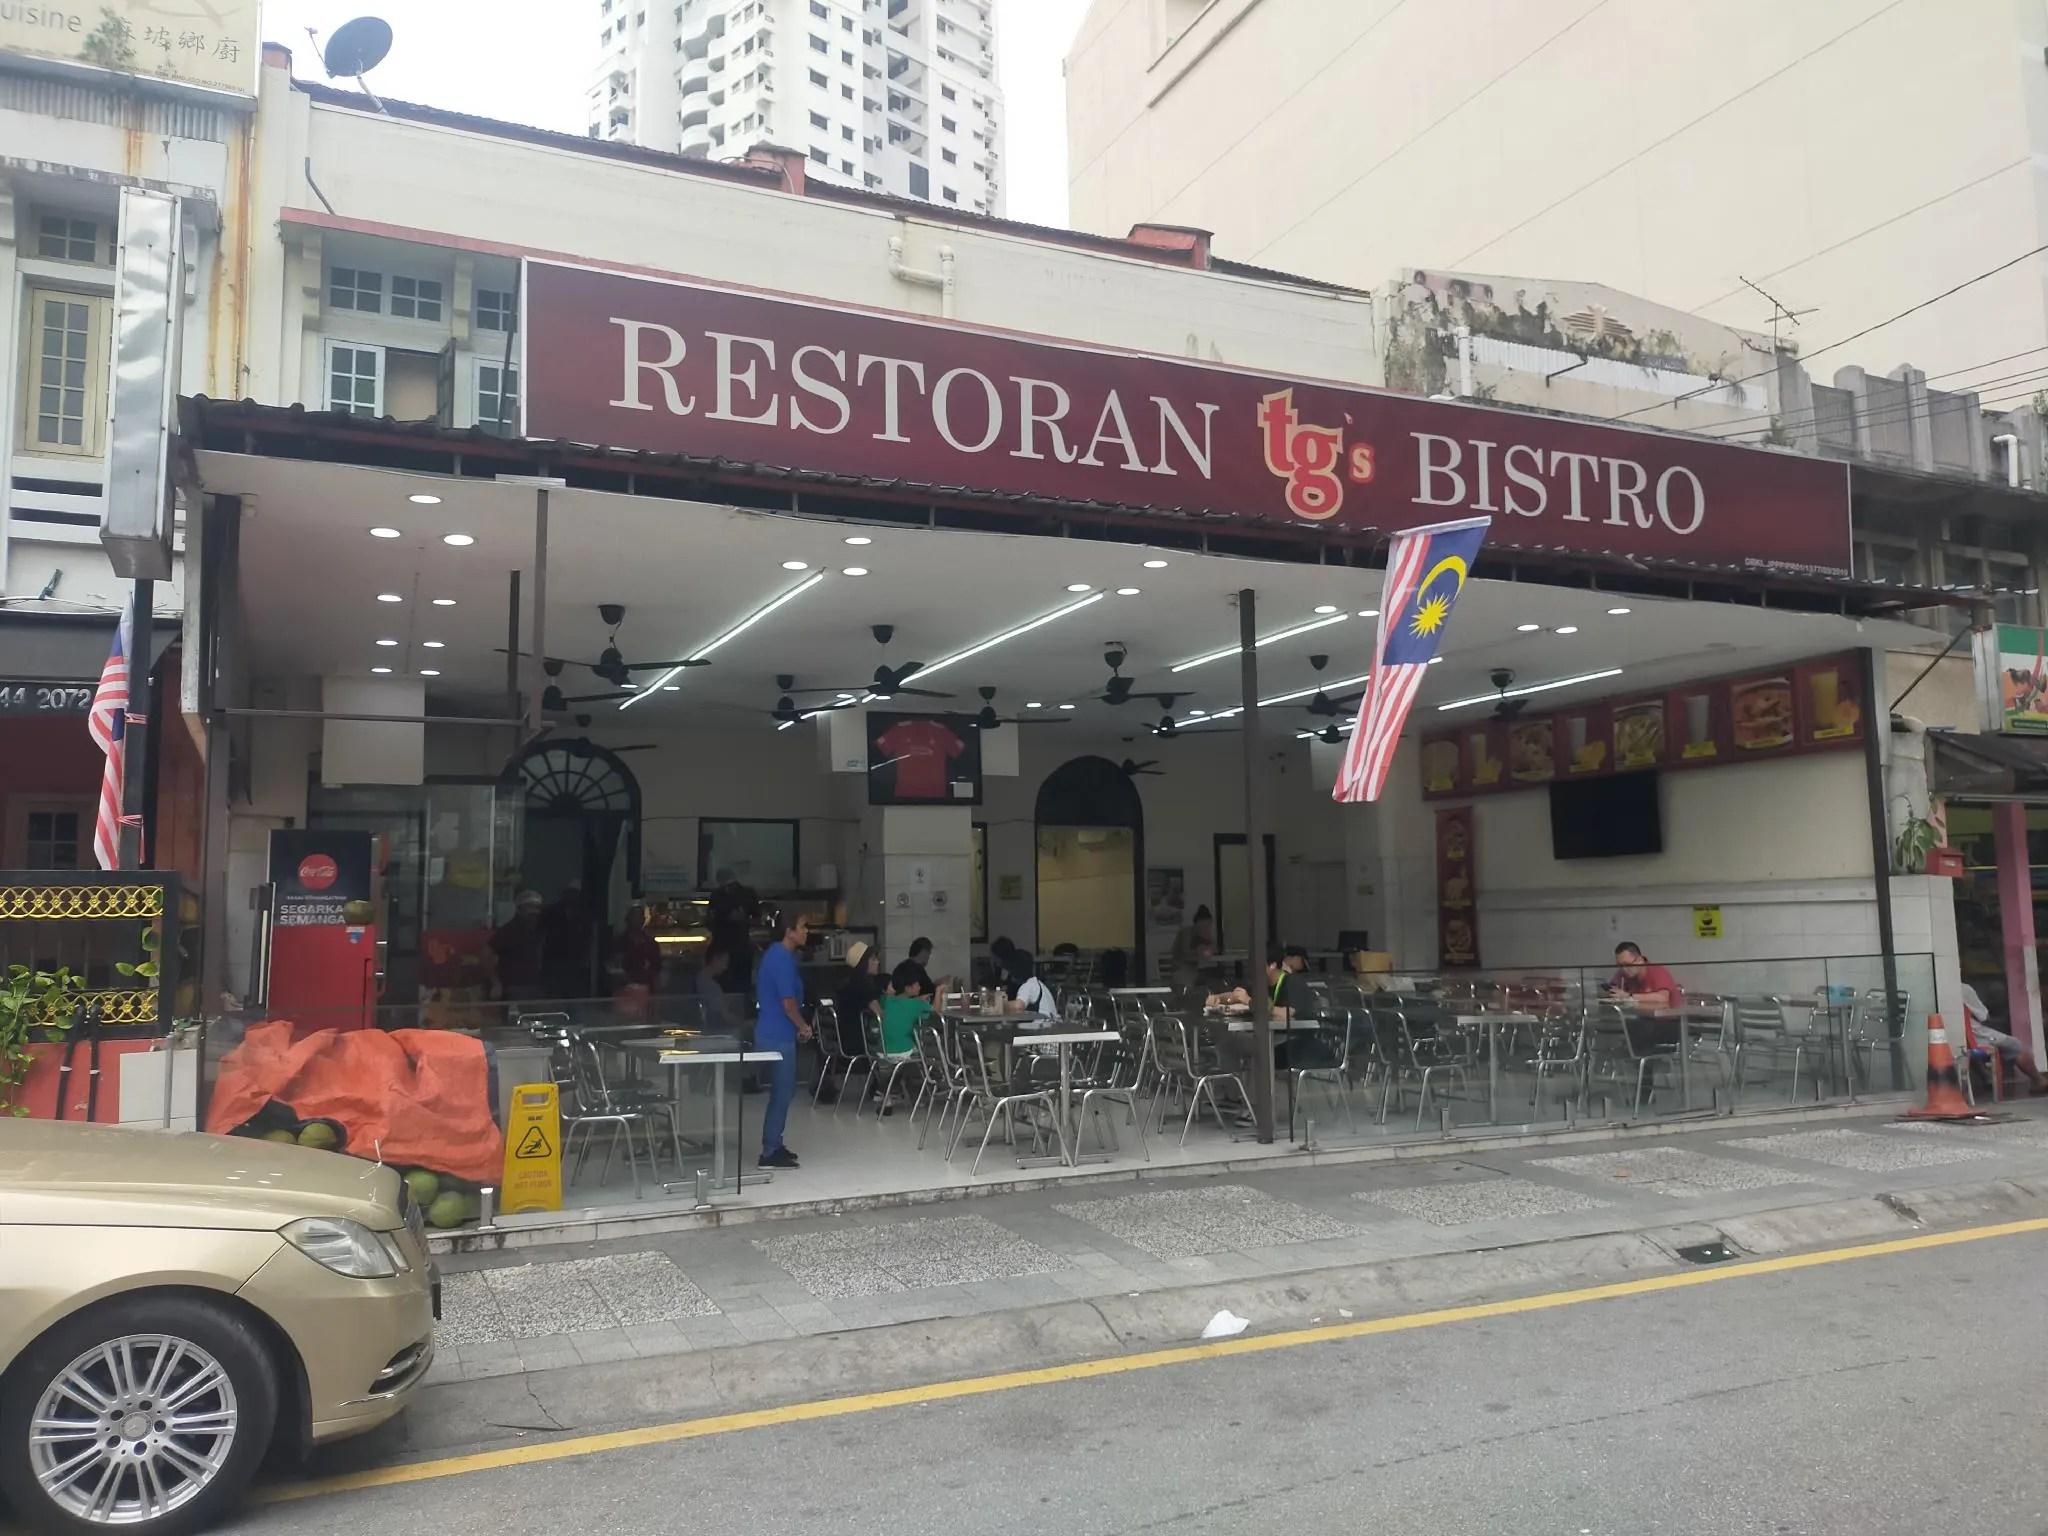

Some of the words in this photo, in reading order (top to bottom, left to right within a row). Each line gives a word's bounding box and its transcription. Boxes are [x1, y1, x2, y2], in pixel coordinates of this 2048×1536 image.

[608, 316, 1221, 480] RESTORAN
[1409, 431, 1705, 535] BISTRO
[36, 687, 92, 709] 2072
